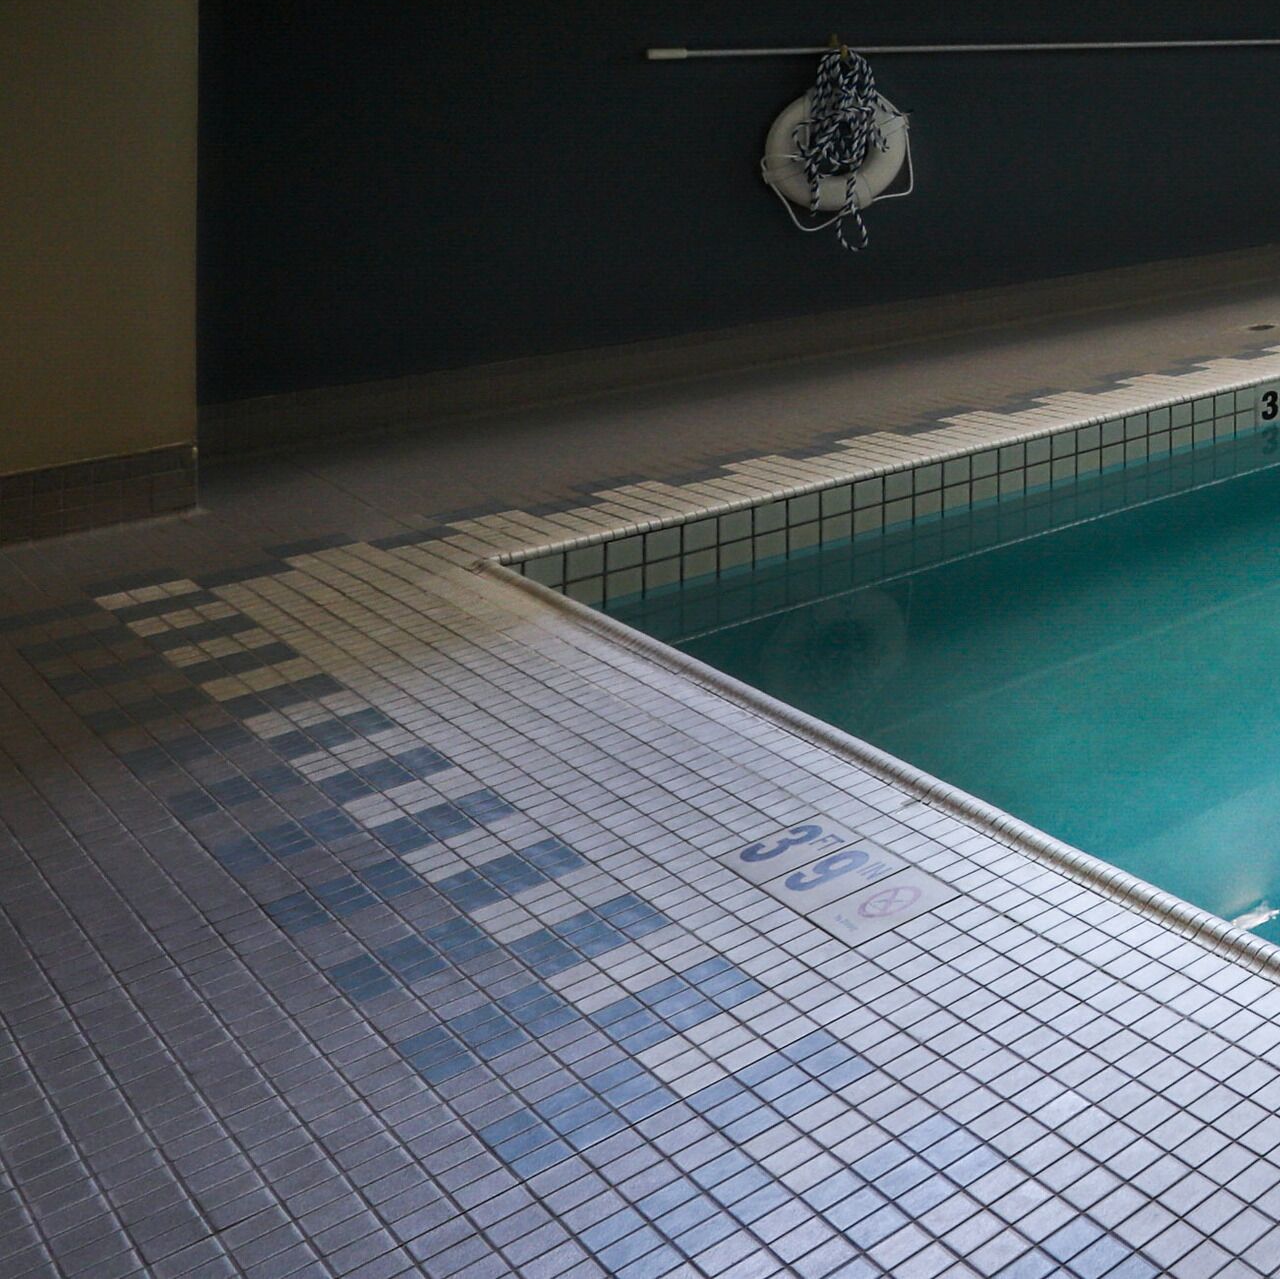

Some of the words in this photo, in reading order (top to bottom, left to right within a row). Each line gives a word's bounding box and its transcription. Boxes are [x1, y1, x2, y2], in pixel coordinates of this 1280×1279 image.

[1261, 390, 1279, 421] 3
[739, 824, 823, 863] 3
[784, 850, 870, 892] 9
